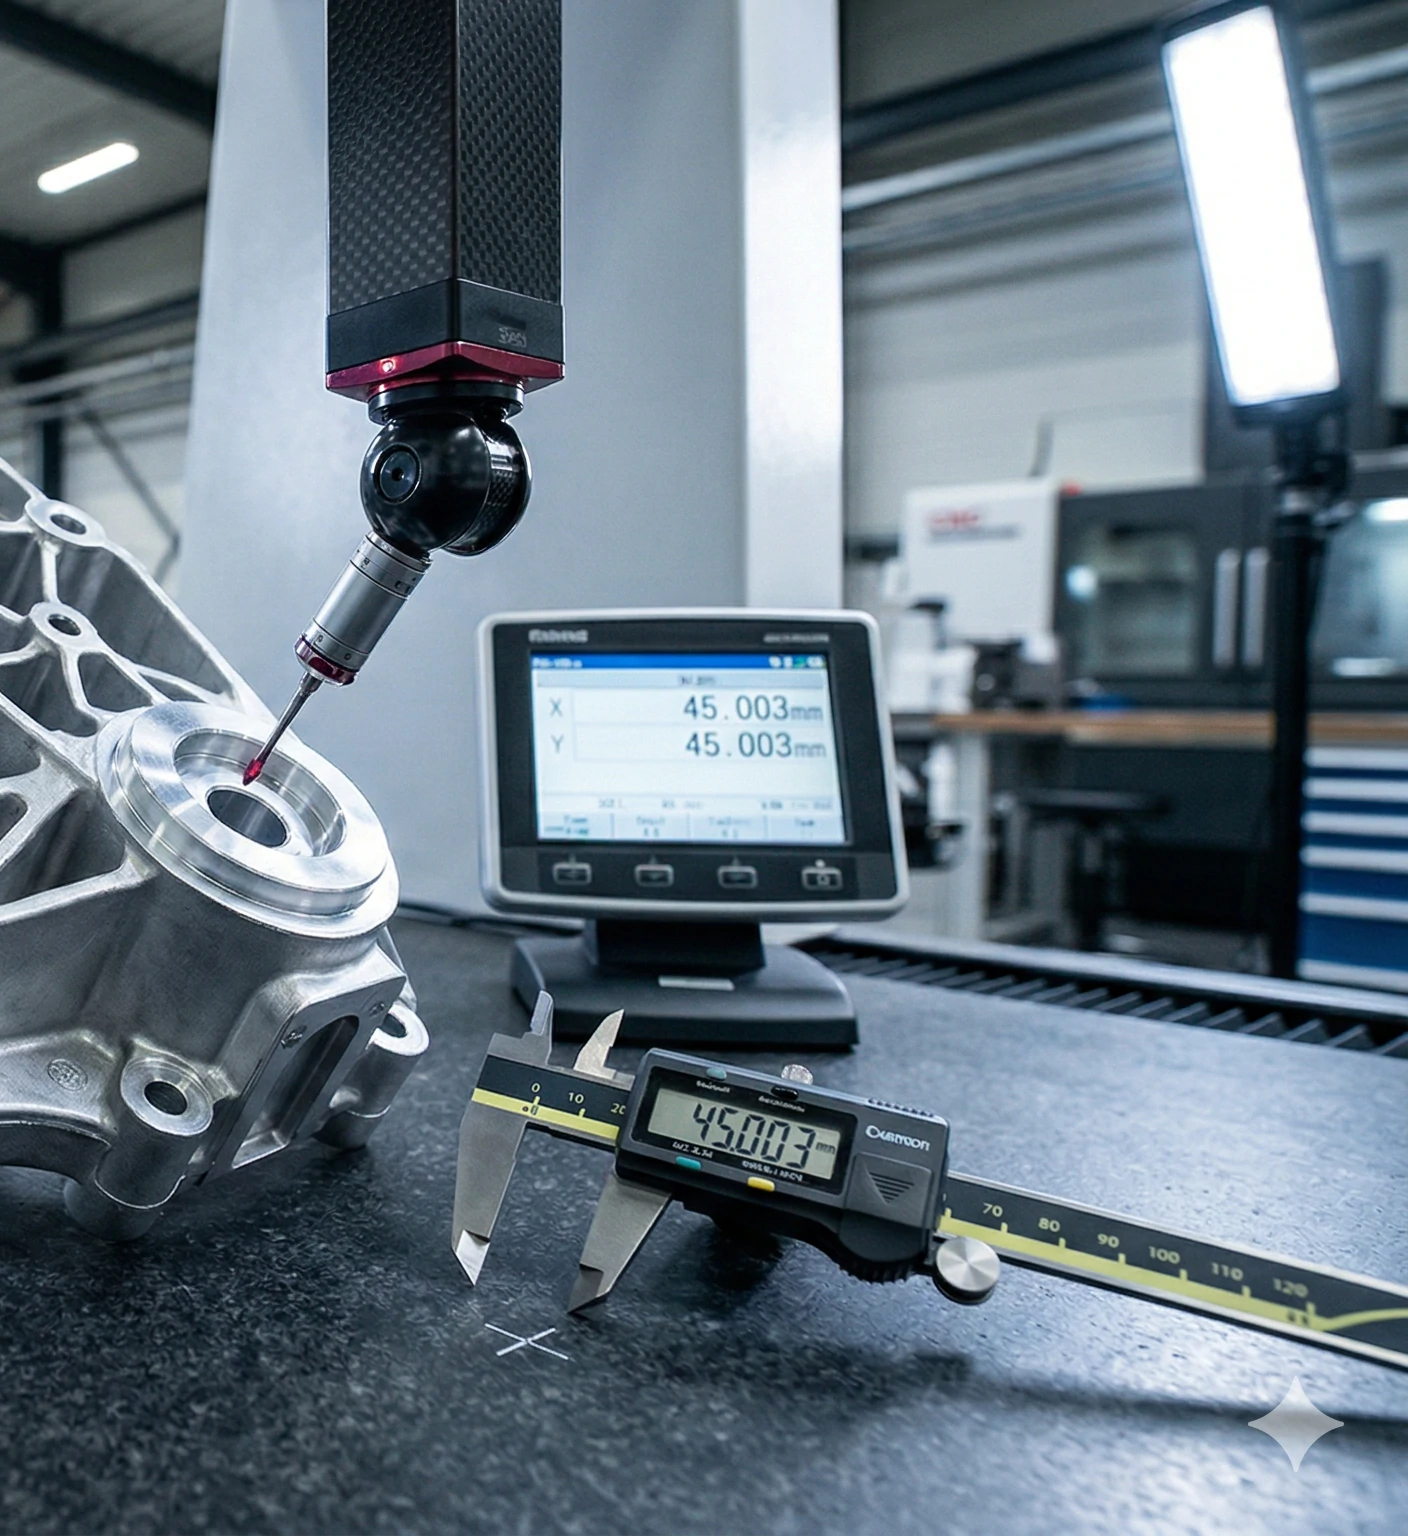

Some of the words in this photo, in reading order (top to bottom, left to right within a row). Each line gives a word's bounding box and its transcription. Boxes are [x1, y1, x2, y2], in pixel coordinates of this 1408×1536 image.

[550, 698, 563, 717] X
[551, 734, 564, 753] Y
[531, 1082, 541, 1093] 0
[568, 1092, 584, 1104] 10
[982, 1202, 1003, 1218] 70
[1038, 1217, 1061, 1233] 80
[1096, 1233, 1120, 1249] 90
[1148, 1246, 1181, 1265] 100
[1211, 1262, 1244, 1282] 110
[1272, 1278, 1309, 1298] 120
